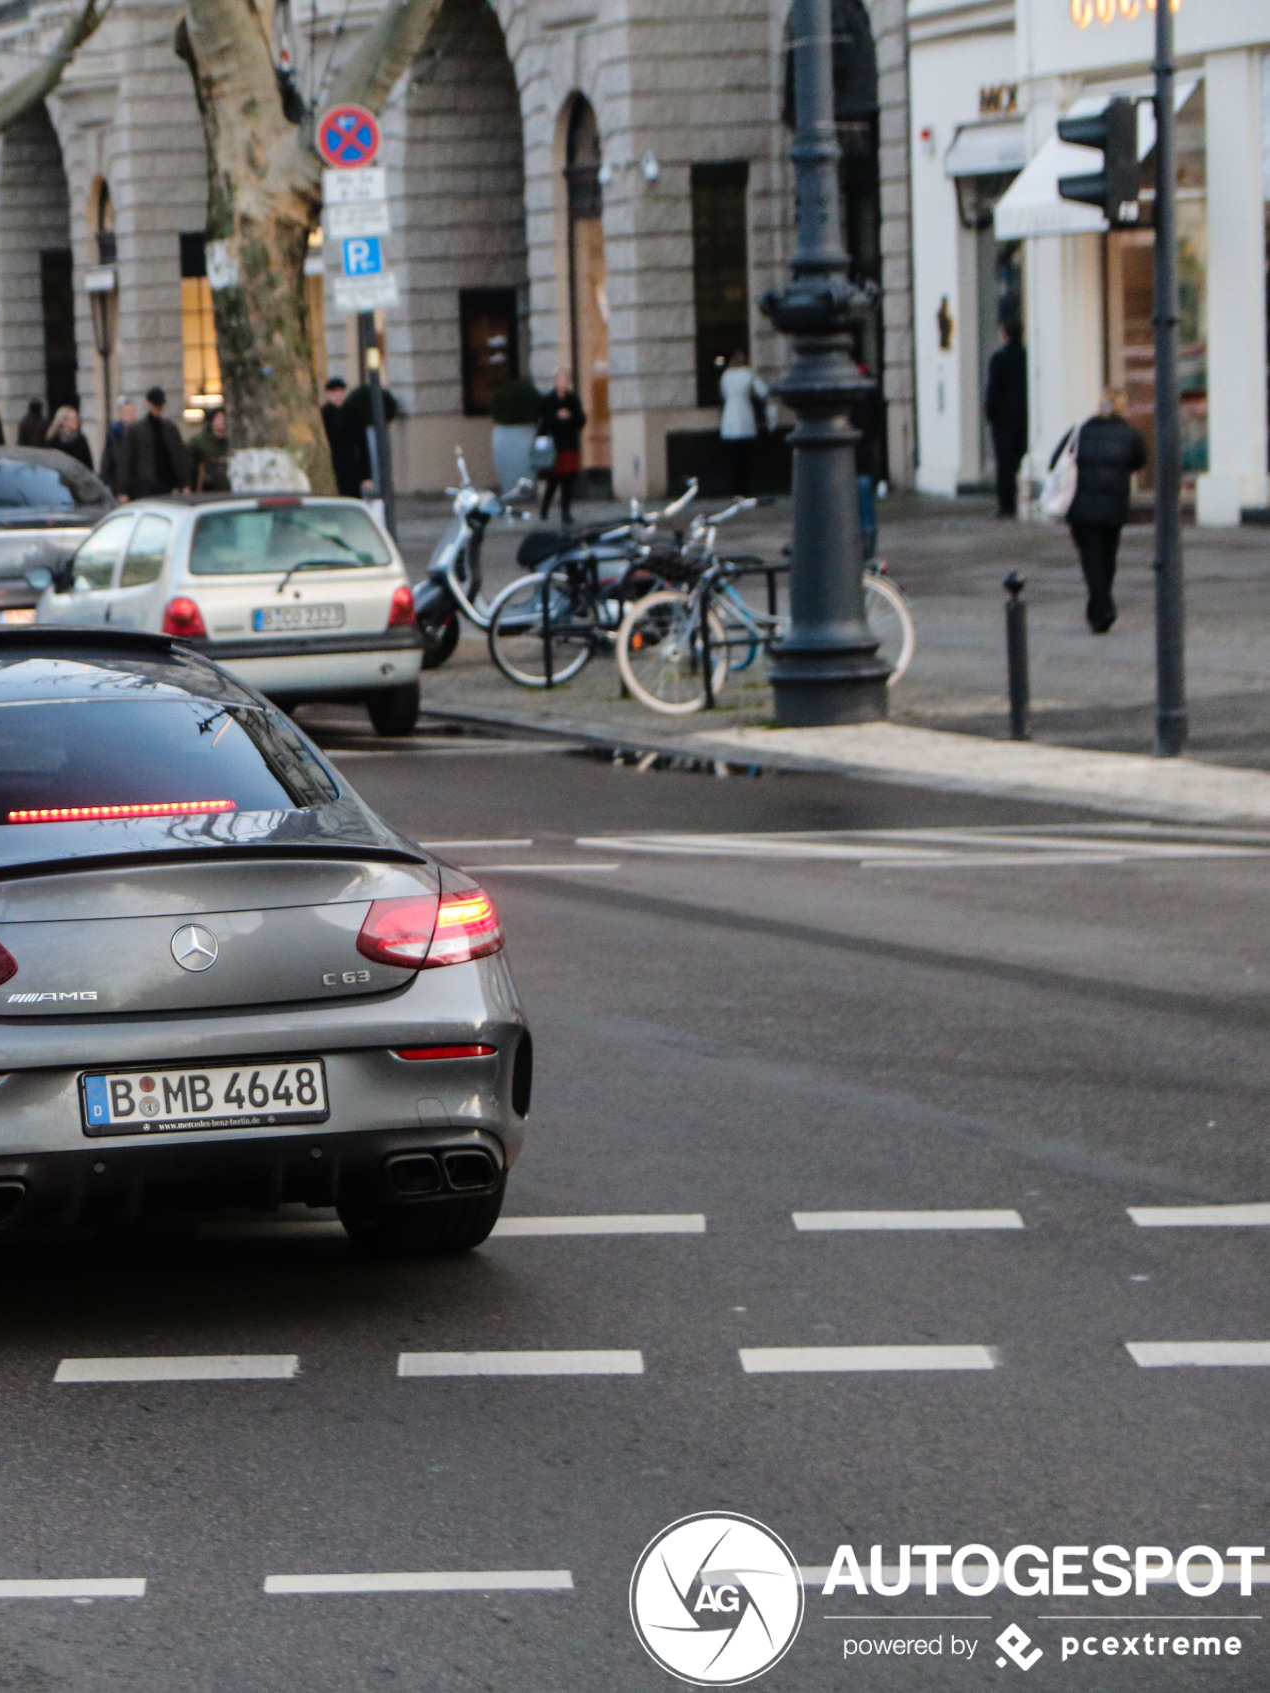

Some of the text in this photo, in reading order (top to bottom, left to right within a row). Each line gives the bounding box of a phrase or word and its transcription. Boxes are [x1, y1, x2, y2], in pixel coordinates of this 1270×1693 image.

[323, 970, 370, 986] C 63
[34, 991, 98, 1002] AMG
[110, 1067, 318, 1118] B MB 4648
[93, 1105, 103, 1117] D
[158, 1116, 261, 1131] www.mercedes-benz-berlin.de
